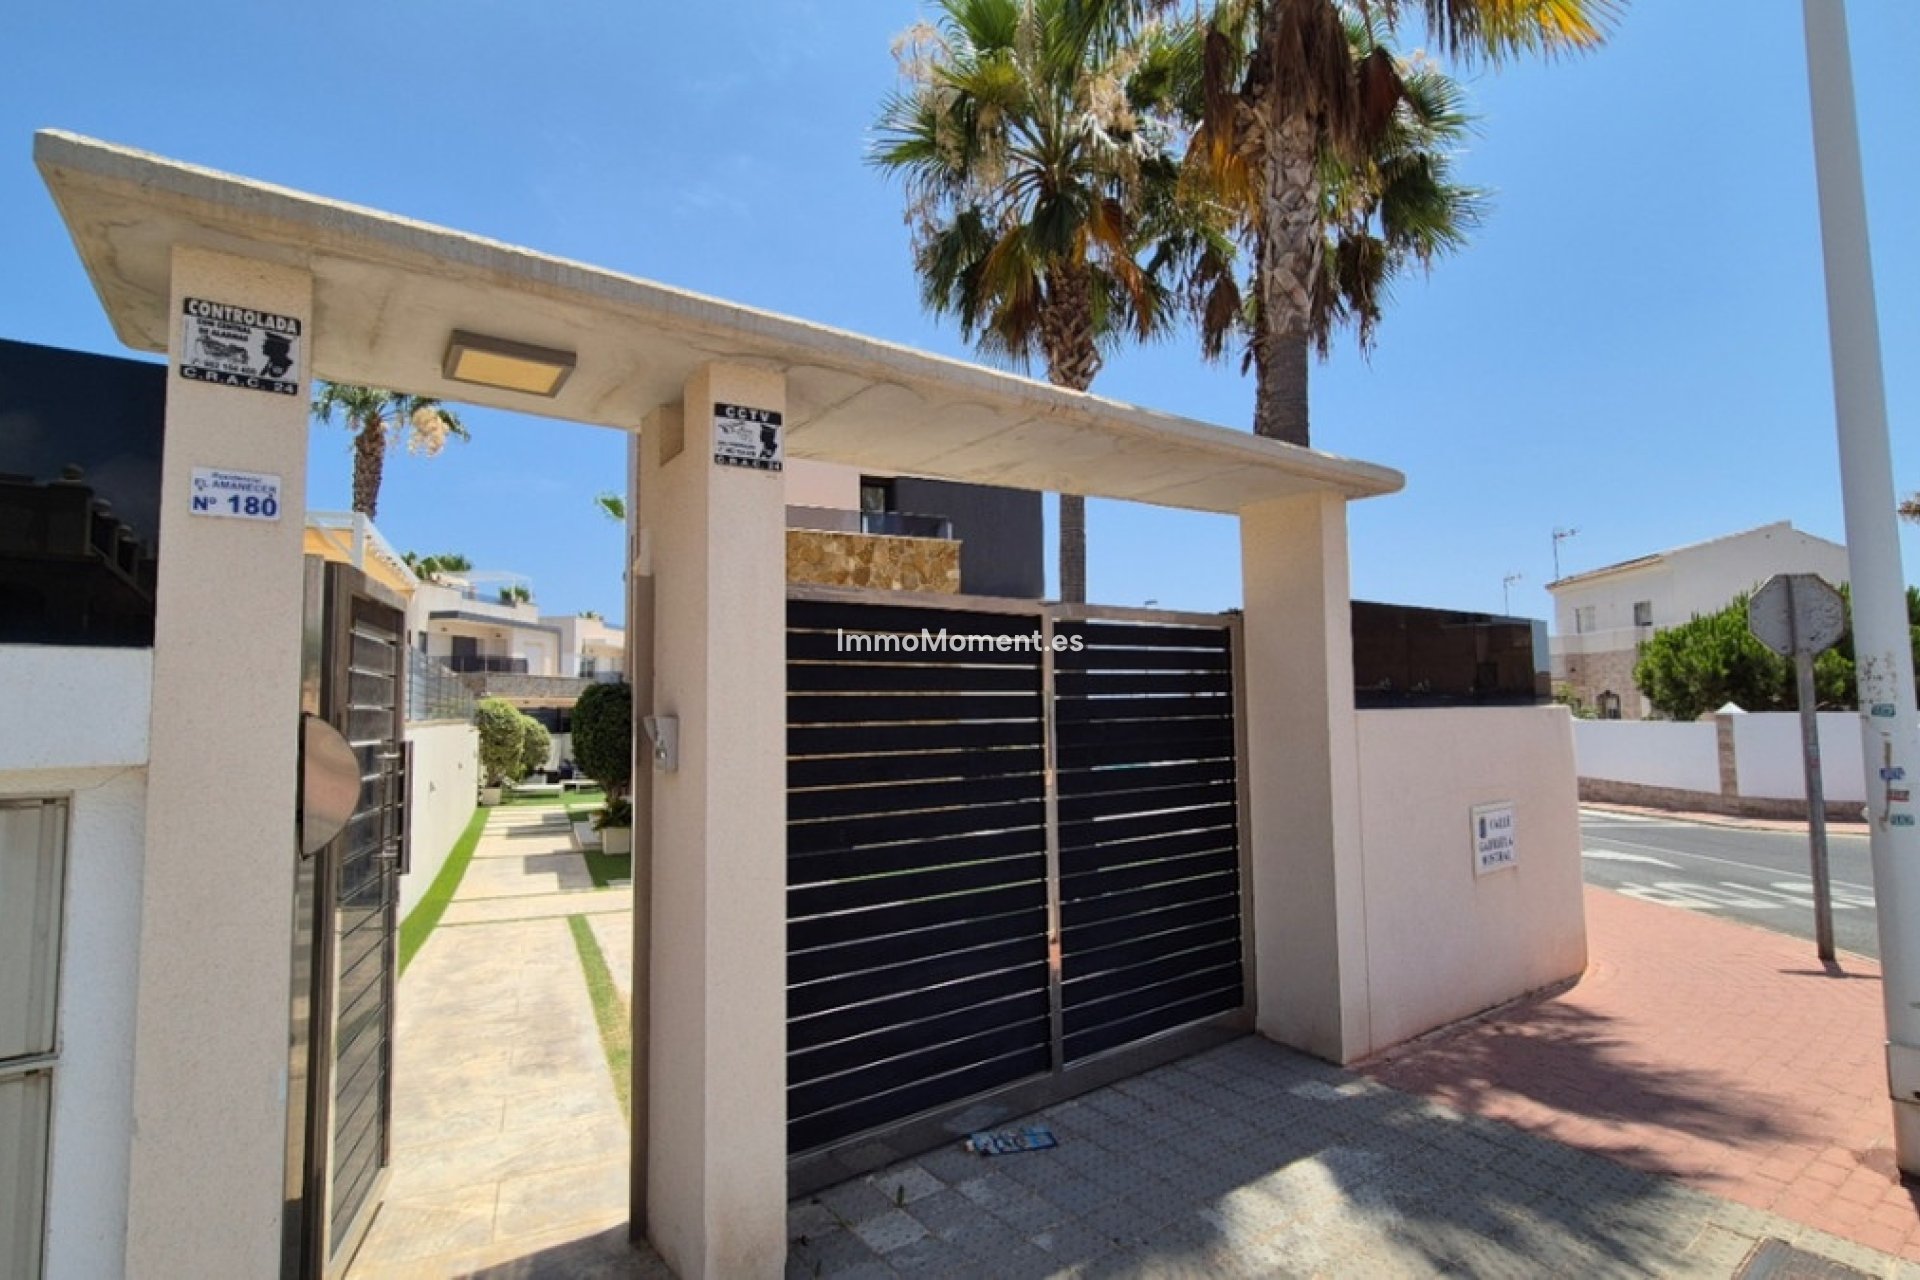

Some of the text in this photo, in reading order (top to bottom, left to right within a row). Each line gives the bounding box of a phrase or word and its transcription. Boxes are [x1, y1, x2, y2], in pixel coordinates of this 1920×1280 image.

[188, 300, 298, 334] CONTROLADA
[725, 406, 770, 422] CCTV
[226, 494, 277, 517] 180
